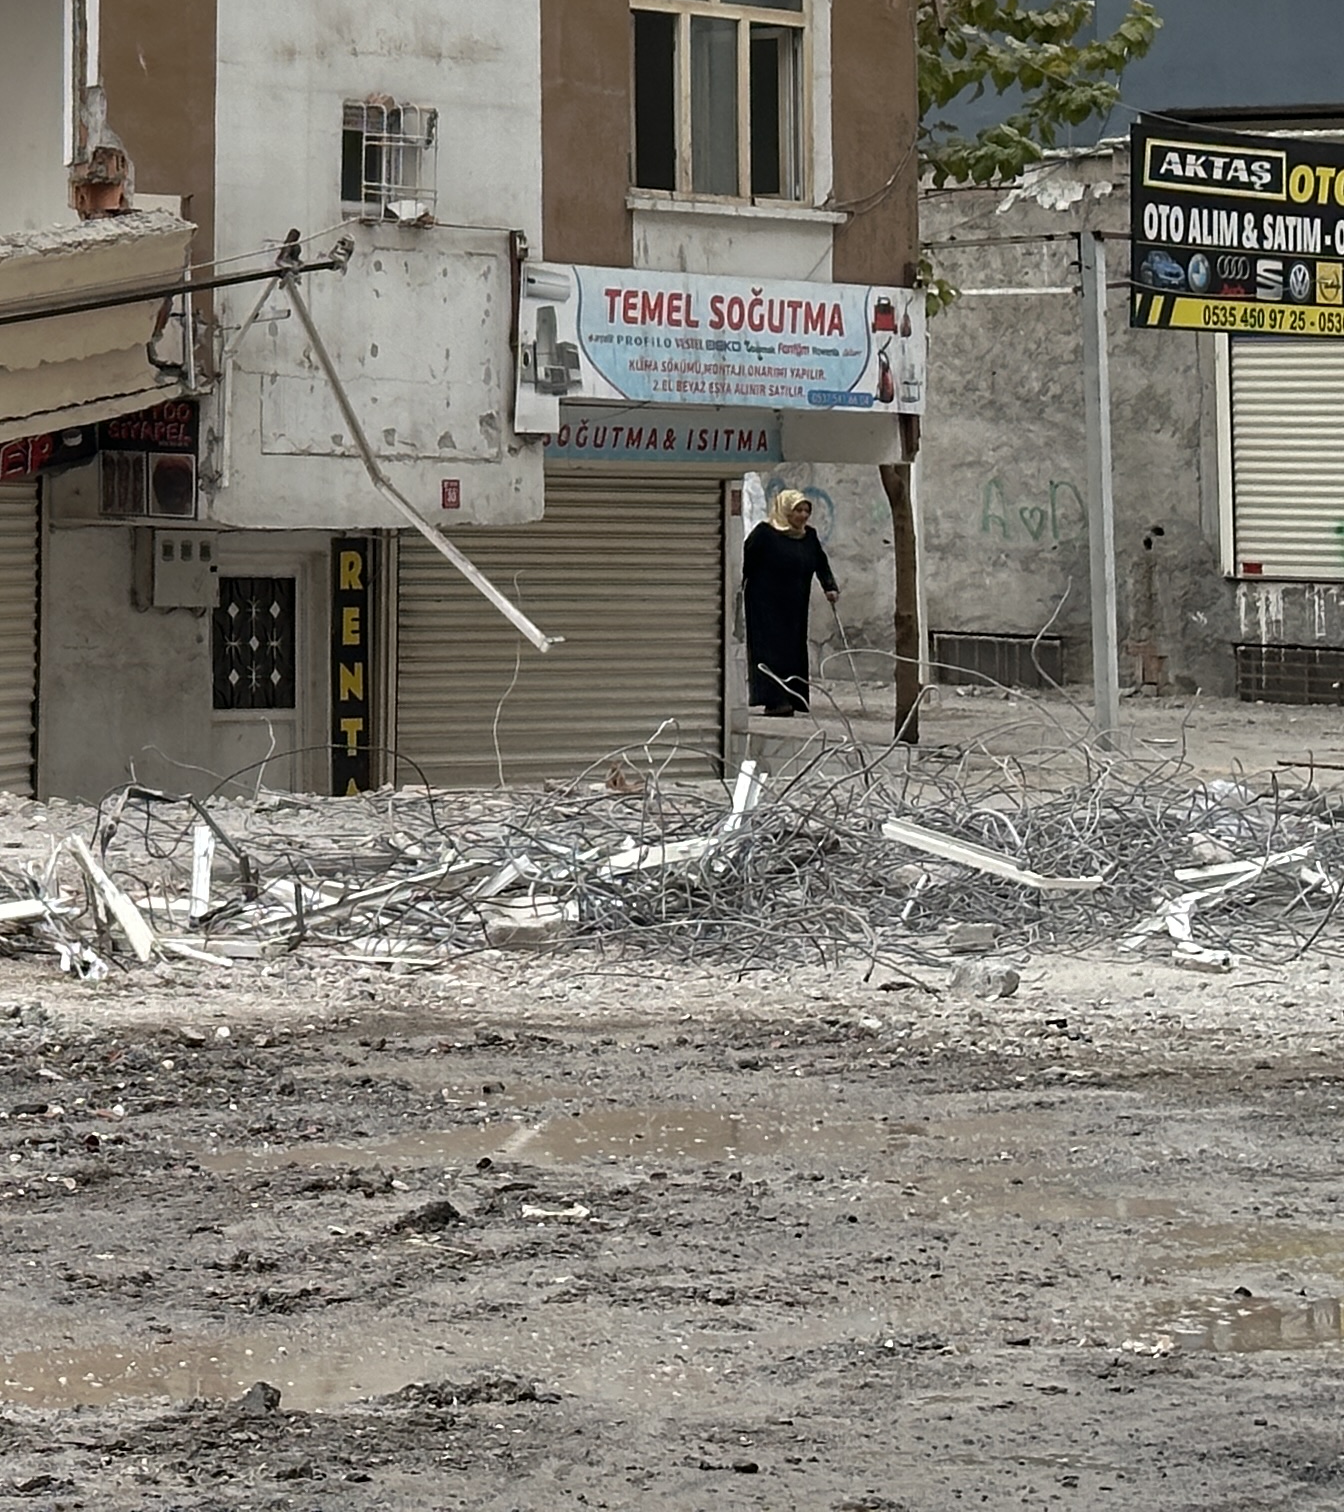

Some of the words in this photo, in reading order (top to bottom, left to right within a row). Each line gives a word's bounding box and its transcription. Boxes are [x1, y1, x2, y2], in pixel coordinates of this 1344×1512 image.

[1159, 151, 1272, 190] AKTAŞ
[1143, 202, 1185, 243] OTO
[1188, 207, 1238, 247] ALIM
[1241, 212, 1260, 249] &
[1262, 213, 1322, 254] SATIM
[604, 288, 700, 329] TEMEL
[708, 287, 845, 337] SOĞUTMA
[1203, 304, 1237, 327] 0535
[1268, 309, 1285, 330] 97
[1289, 310, 1306, 331] 25
[675, 380, 706, 394] BEYAZ
[686, 428, 769, 452] ISITMA
